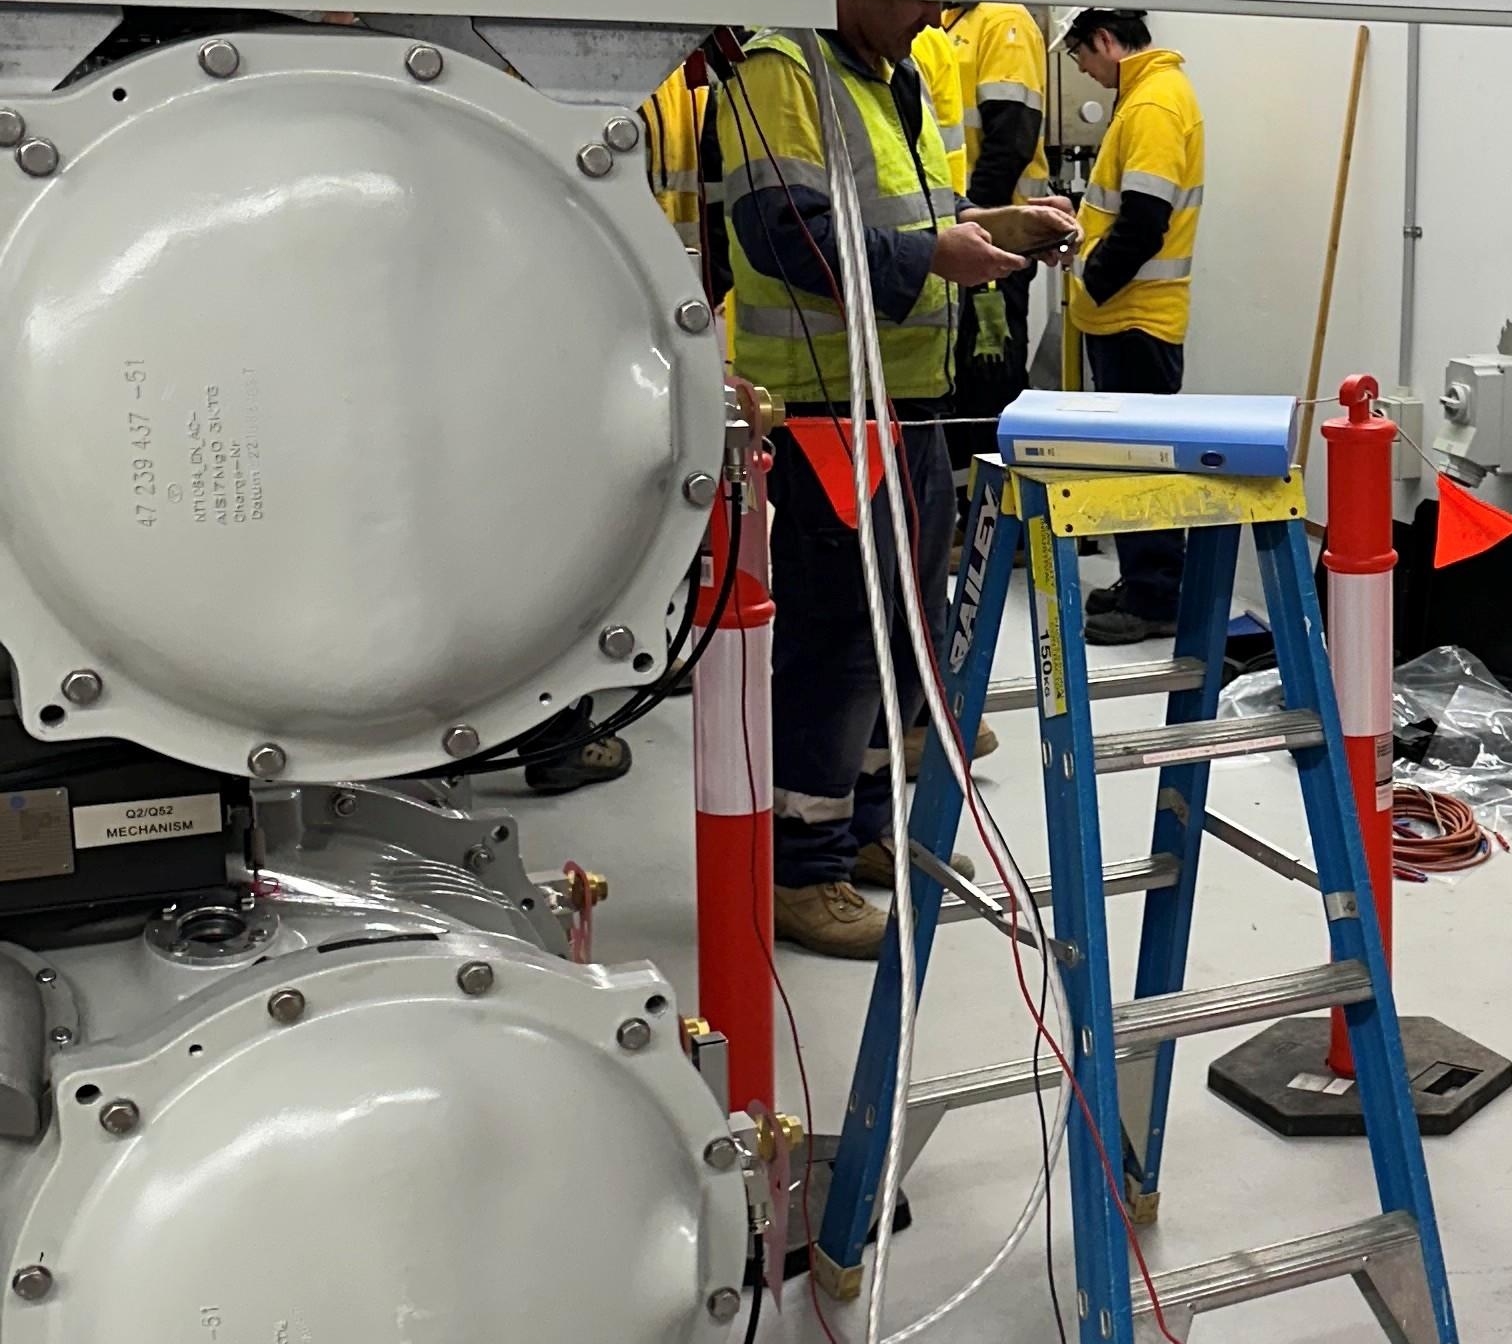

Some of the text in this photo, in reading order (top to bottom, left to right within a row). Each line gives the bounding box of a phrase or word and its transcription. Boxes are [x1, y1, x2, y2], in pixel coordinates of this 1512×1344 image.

[129, 412, 151, 450] 437
[131, 459, 156, 496] 239
[135, 504, 157, 527] 47
[949, 483, 1000, 674] BAILEY
[125, 805, 174, 819] Q2/Q52
[106, 820, 194, 840] MECHANISM
